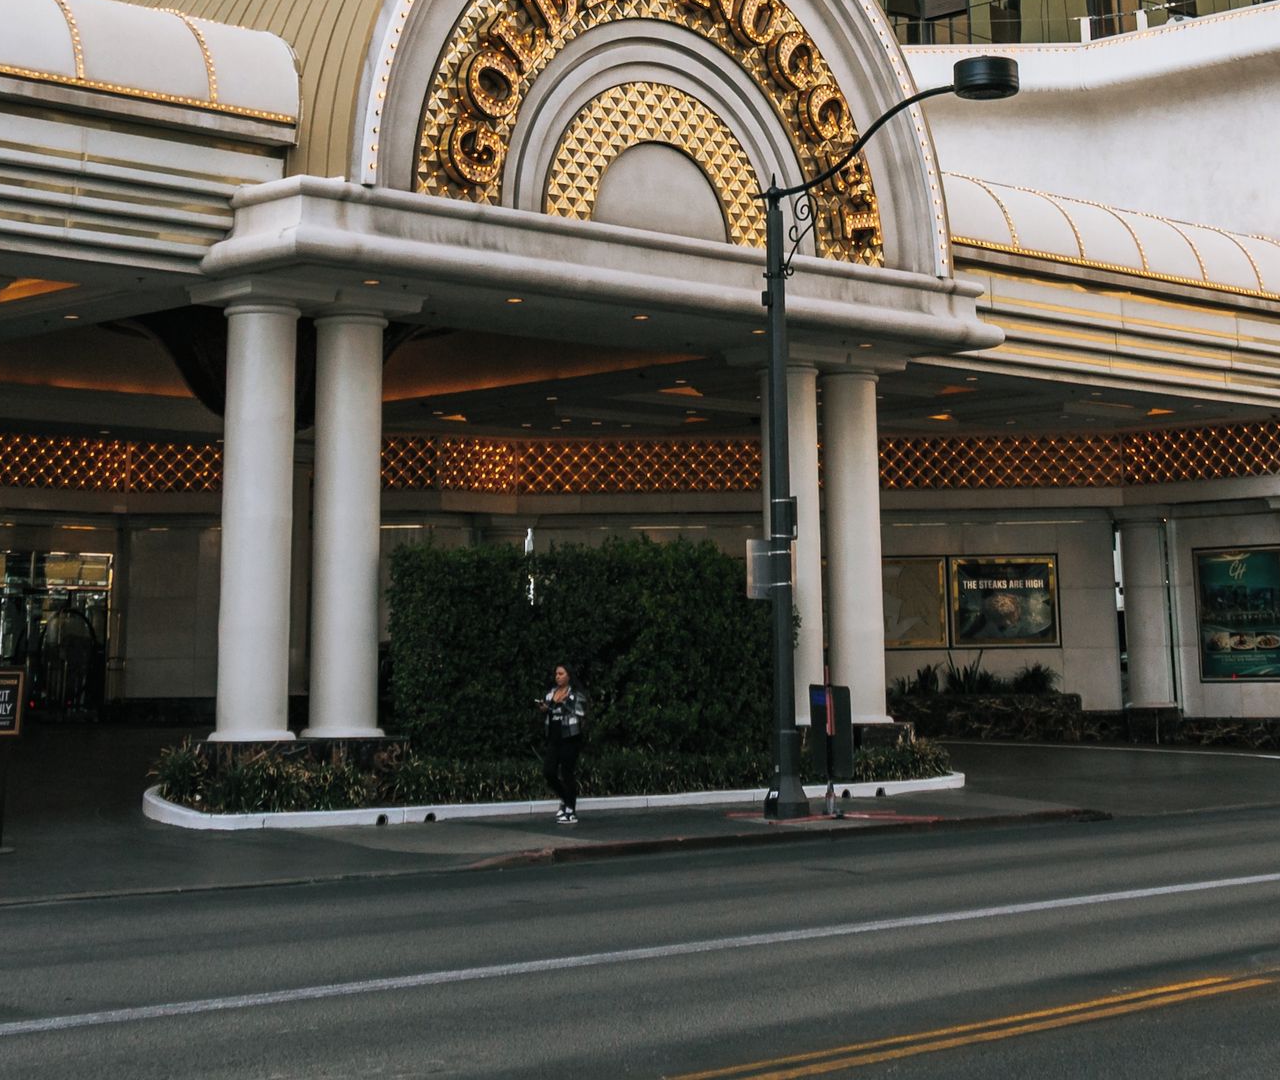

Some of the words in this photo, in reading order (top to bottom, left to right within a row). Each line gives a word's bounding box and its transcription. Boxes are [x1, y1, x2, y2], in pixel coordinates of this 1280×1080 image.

[963, 580, 977, 589] THE
[979, 580, 1007, 589] STEAKS
[1009, 580, 1023, 589] ARE
[1025, 579, 1044, 588] HIGH
